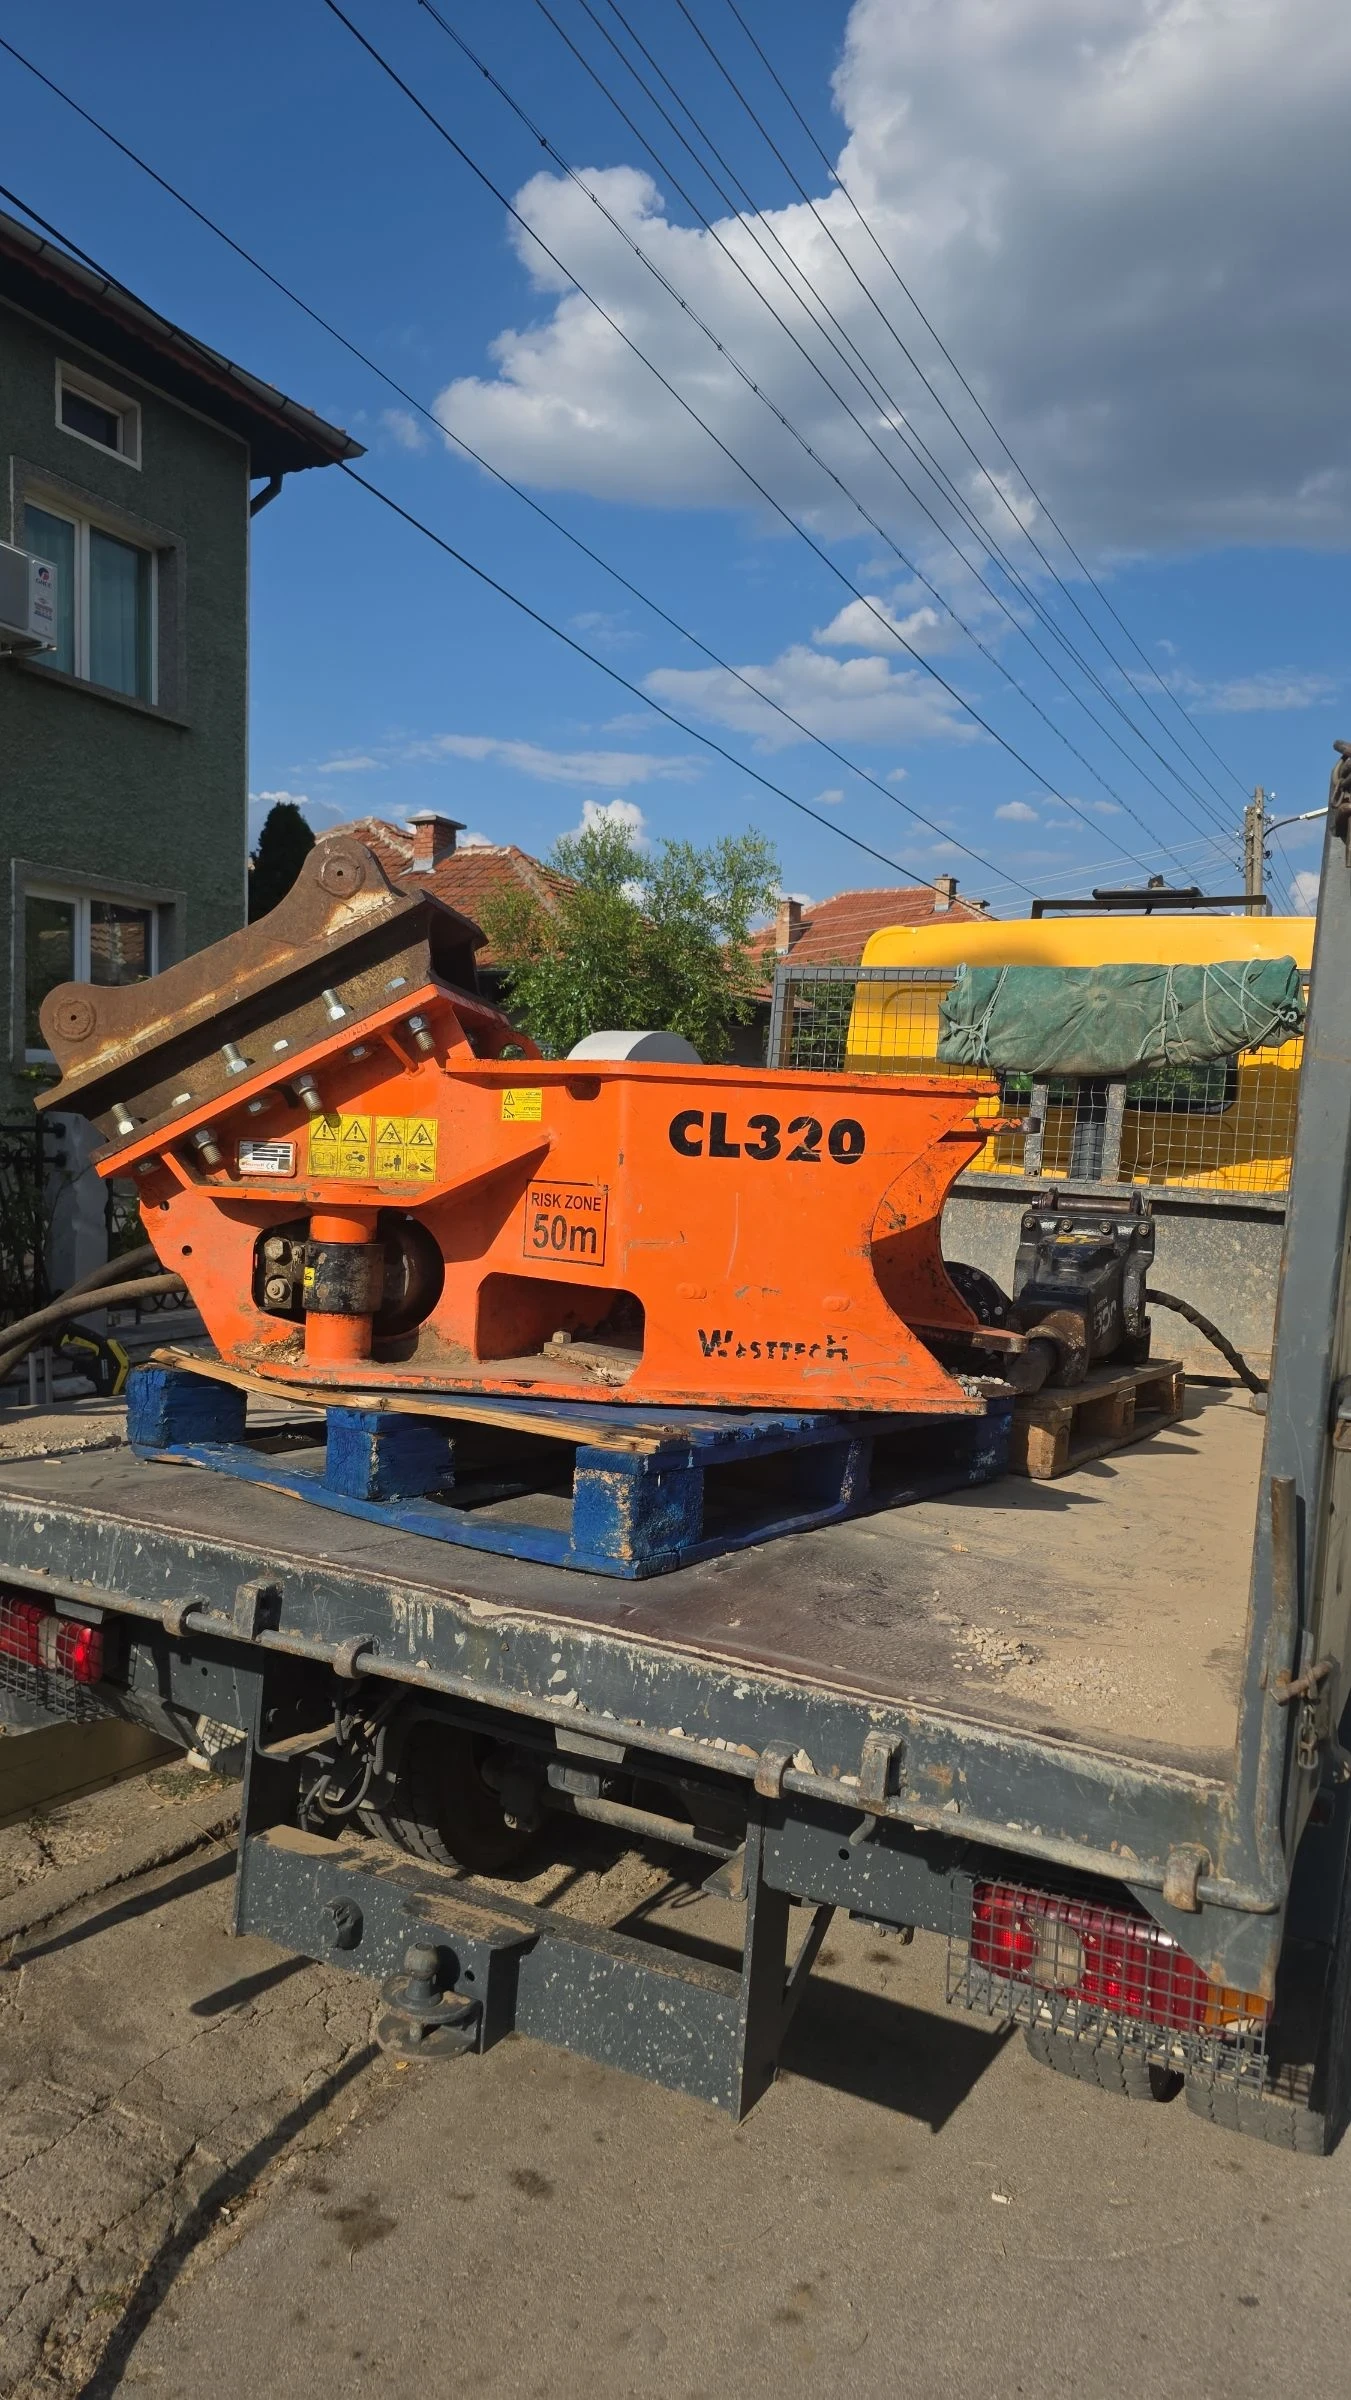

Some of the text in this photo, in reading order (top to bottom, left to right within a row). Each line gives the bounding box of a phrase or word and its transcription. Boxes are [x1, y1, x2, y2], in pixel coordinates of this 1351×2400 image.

[668, 1109, 865, 1164] CL320
[531, 1192, 602, 1212] RISK ZONE
[532, 1213, 597, 1254] 50m
